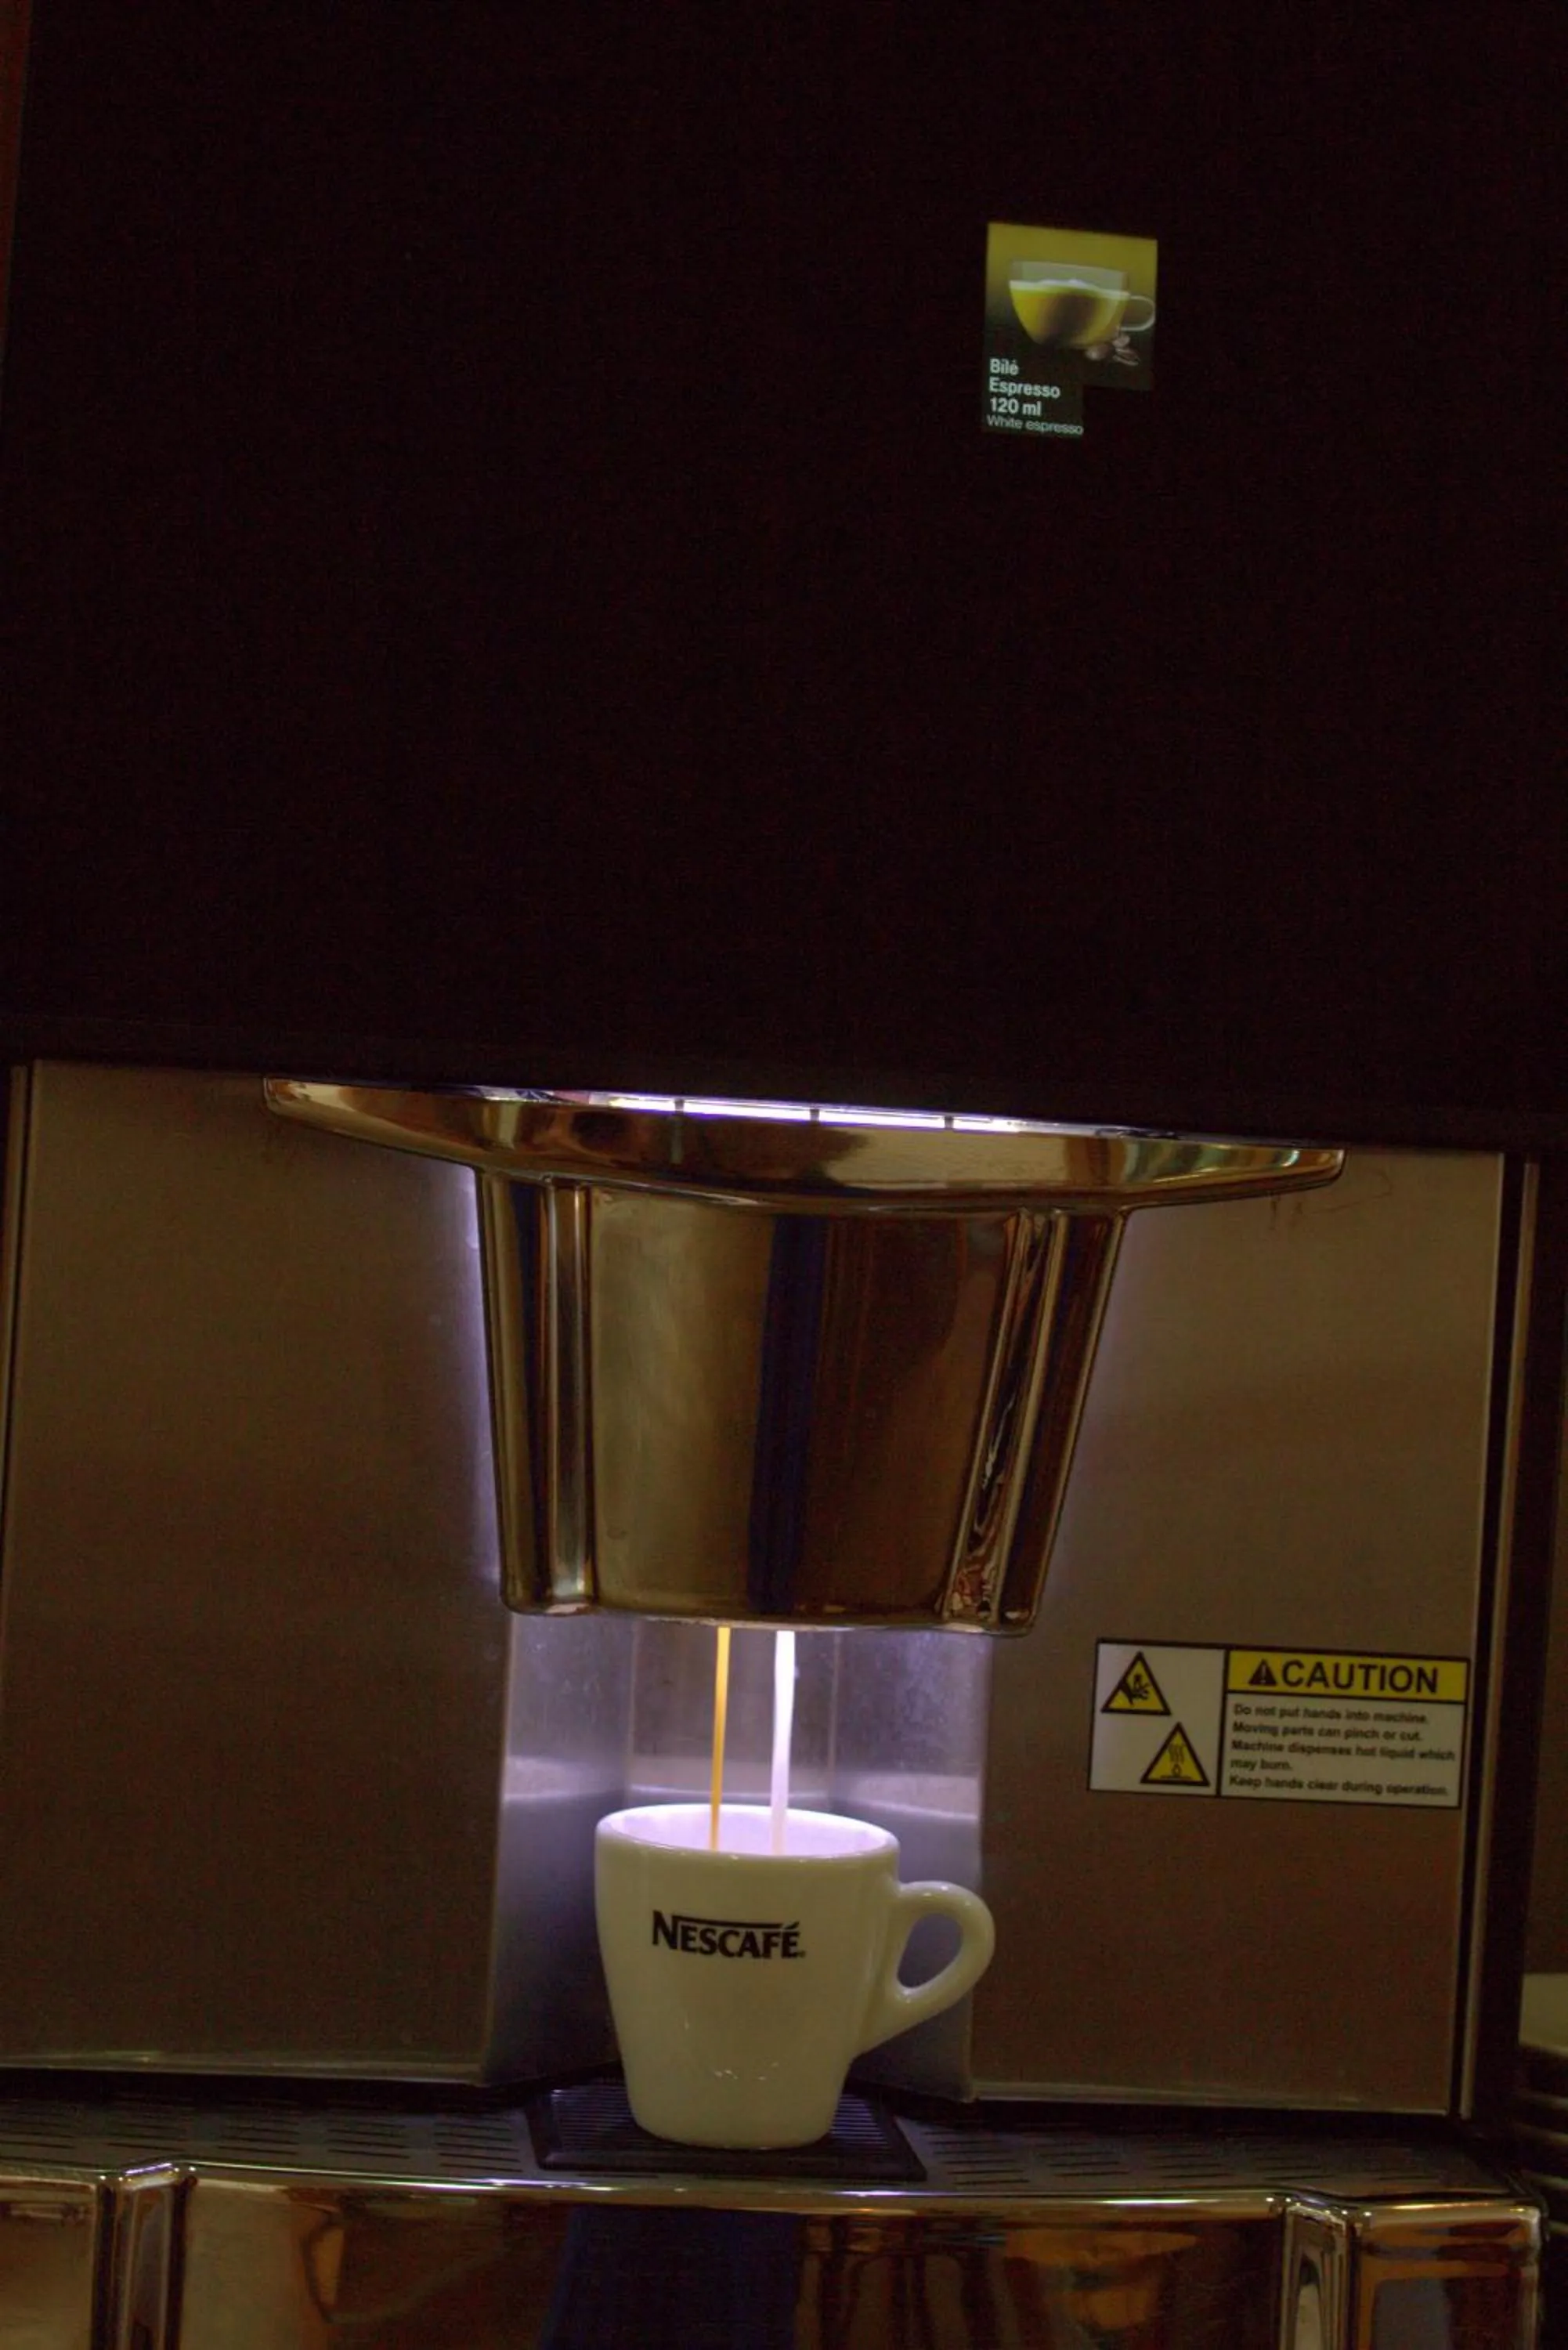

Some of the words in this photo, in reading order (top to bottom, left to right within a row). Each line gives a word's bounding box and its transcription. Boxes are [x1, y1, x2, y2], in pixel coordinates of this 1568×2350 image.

[989, 358, 1018, 375] Bilé
[988, 377, 1061, 398] Espresso
[990, 396, 1018, 414] 120
[1022, 401, 1042, 416] ml
[987, 414, 1022, 429] White
[1025, 421, 1084, 436] espresso
[1282, 1659, 1438, 1694] CAUTION
[1234, 1704, 1252, 1716] Do
[1255, 1706, 1276, 1716] not
[1279, 1708, 1300, 1719] put
[1302, 1708, 1342, 1719] hands
[1345, 1709, 1371, 1721] into
[1233, 1721, 1279, 1737] Moving
[1282, 1726, 1314, 1738] parts
[1317, 1728, 1341, 1737] can
[1344, 1728, 1380, 1741] pinch
[1382, 1731, 1396, 1740] or
[1231, 1739, 1284, 1752] Machine
[1419, 1748, 1455, 1762] which
[1230, 1759, 1258, 1771] may
[1230, 1775, 1262, 1790] Keep
[1265, 1777, 1304, 1789] hands
[1342, 1781, 1383, 1795] during
